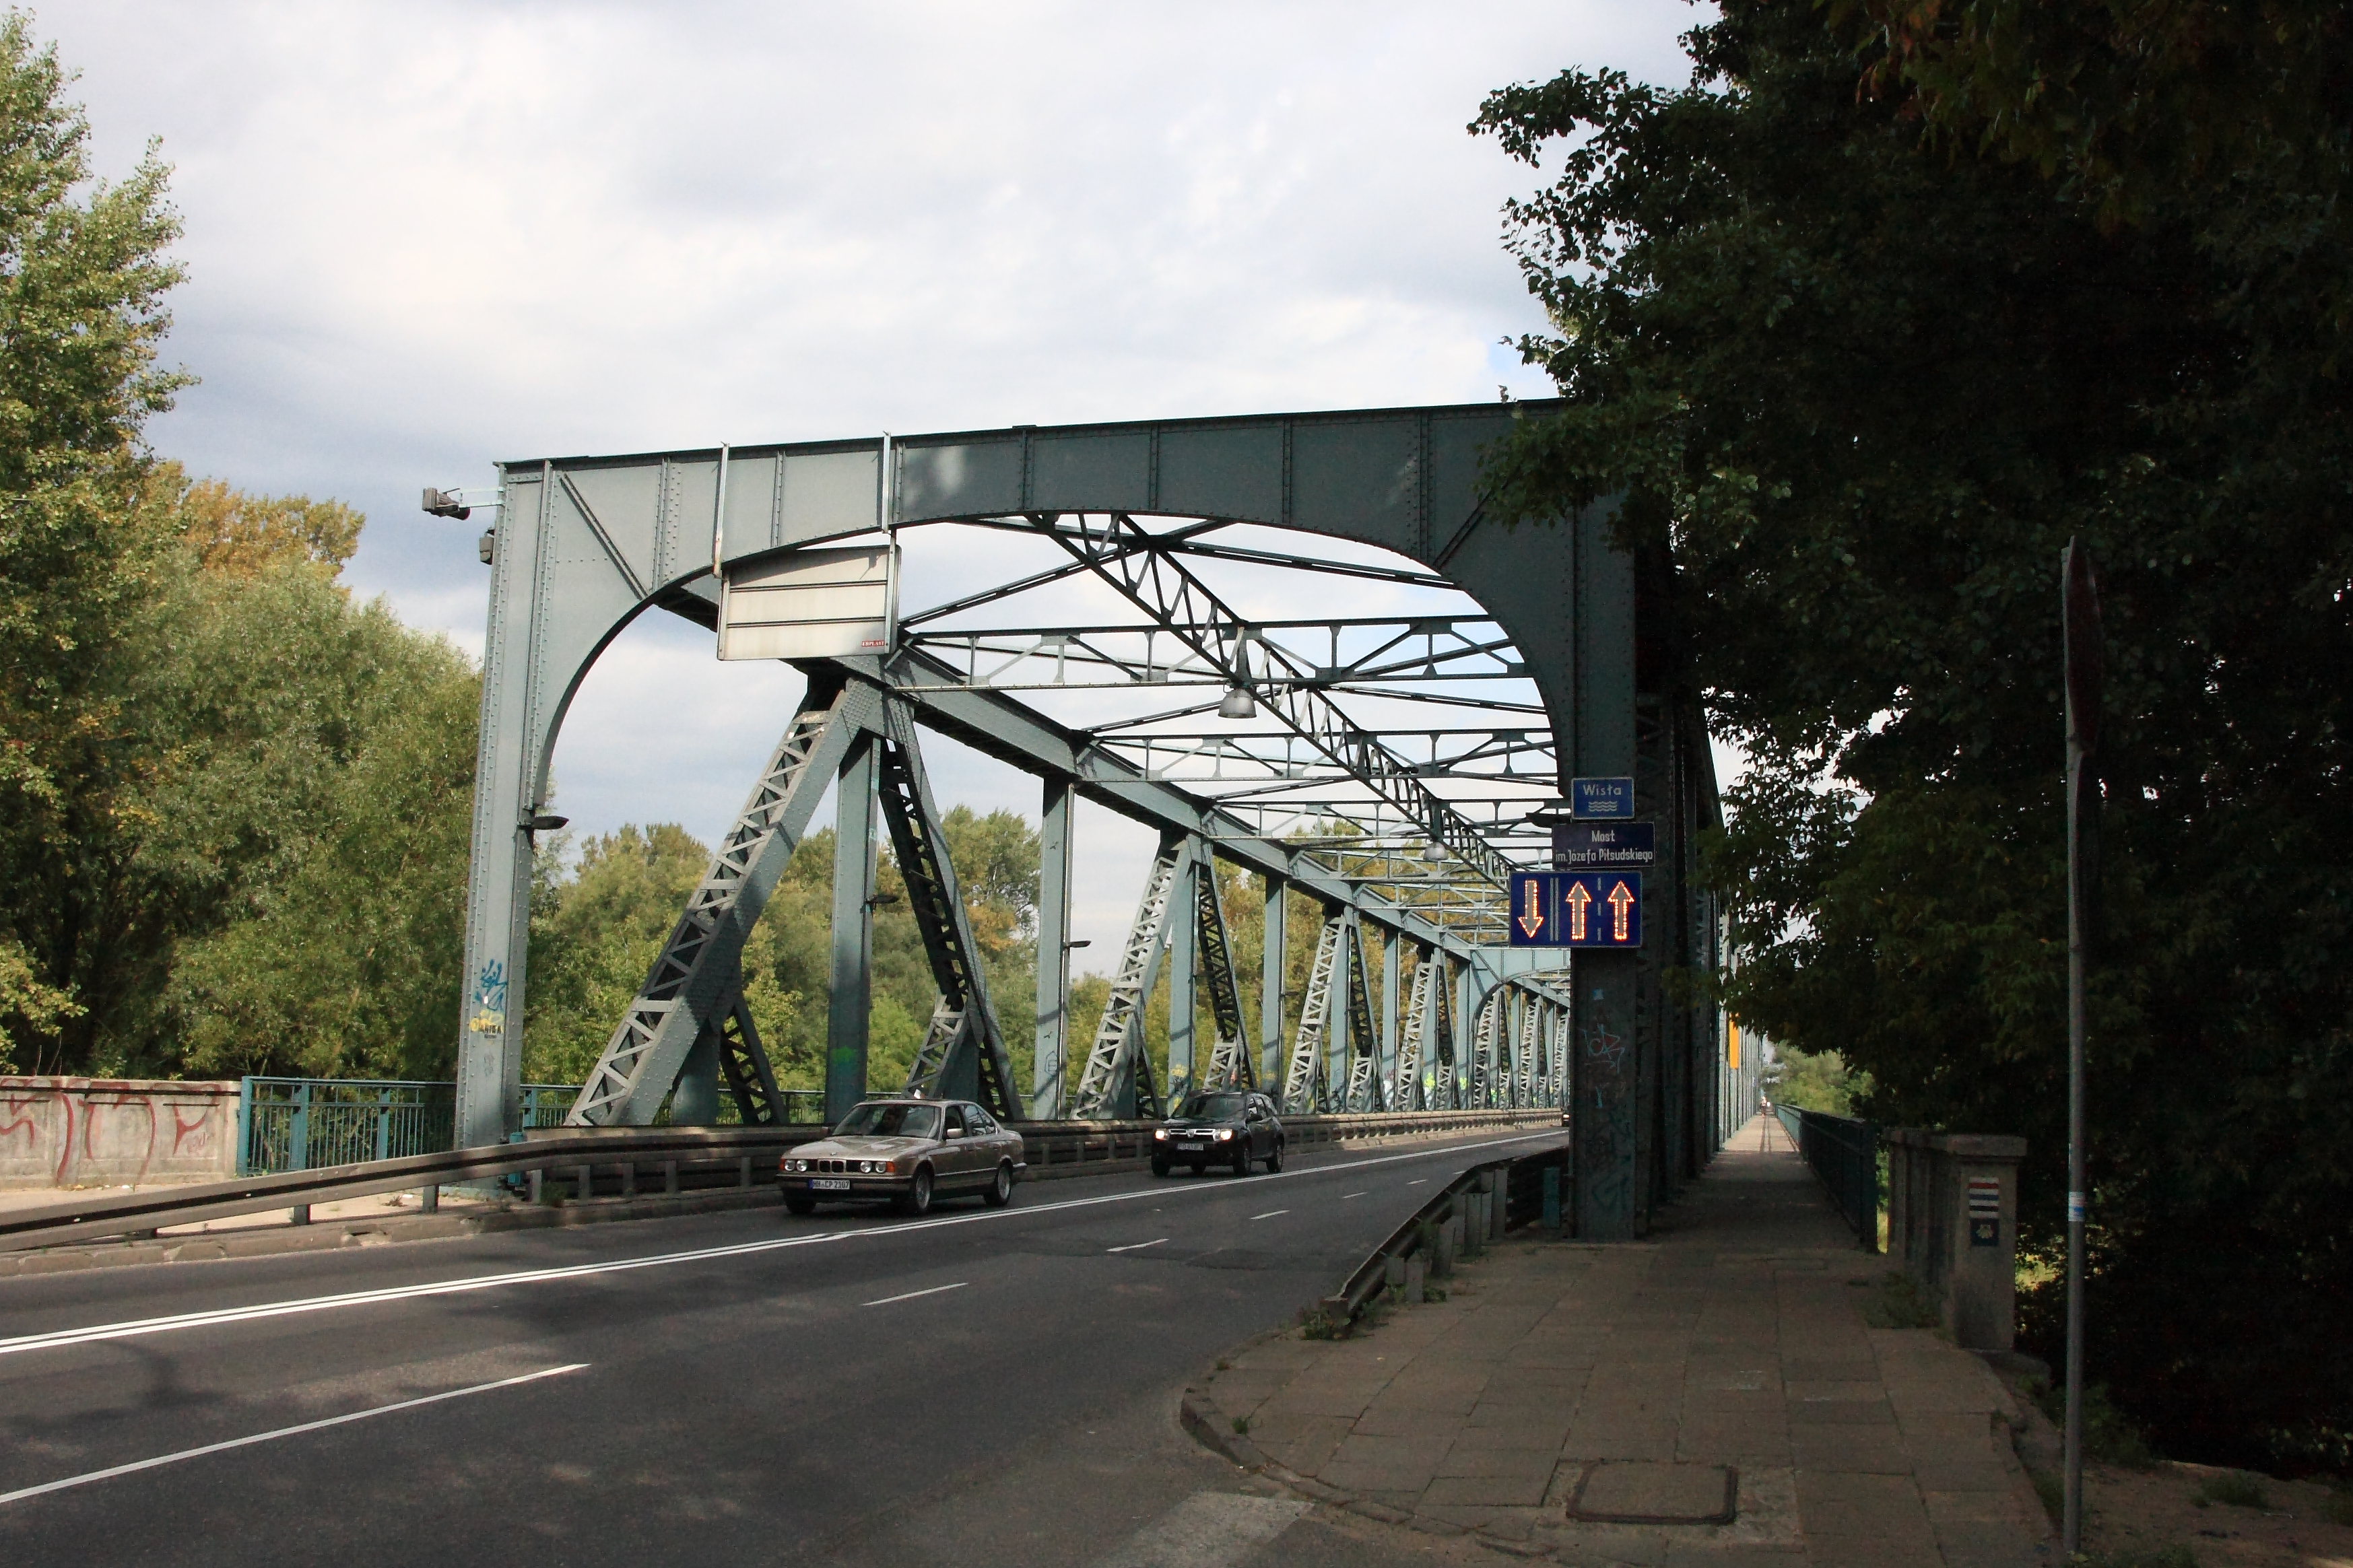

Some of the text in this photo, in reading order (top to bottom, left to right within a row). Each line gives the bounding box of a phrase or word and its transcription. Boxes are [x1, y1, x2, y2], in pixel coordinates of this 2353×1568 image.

[1583, 784, 1622, 796] Wisła
[1591, 829, 1615, 842] Most
[1555, 850, 1567, 862] im.
[1599, 848, 1653, 862] Piłsudskiego
